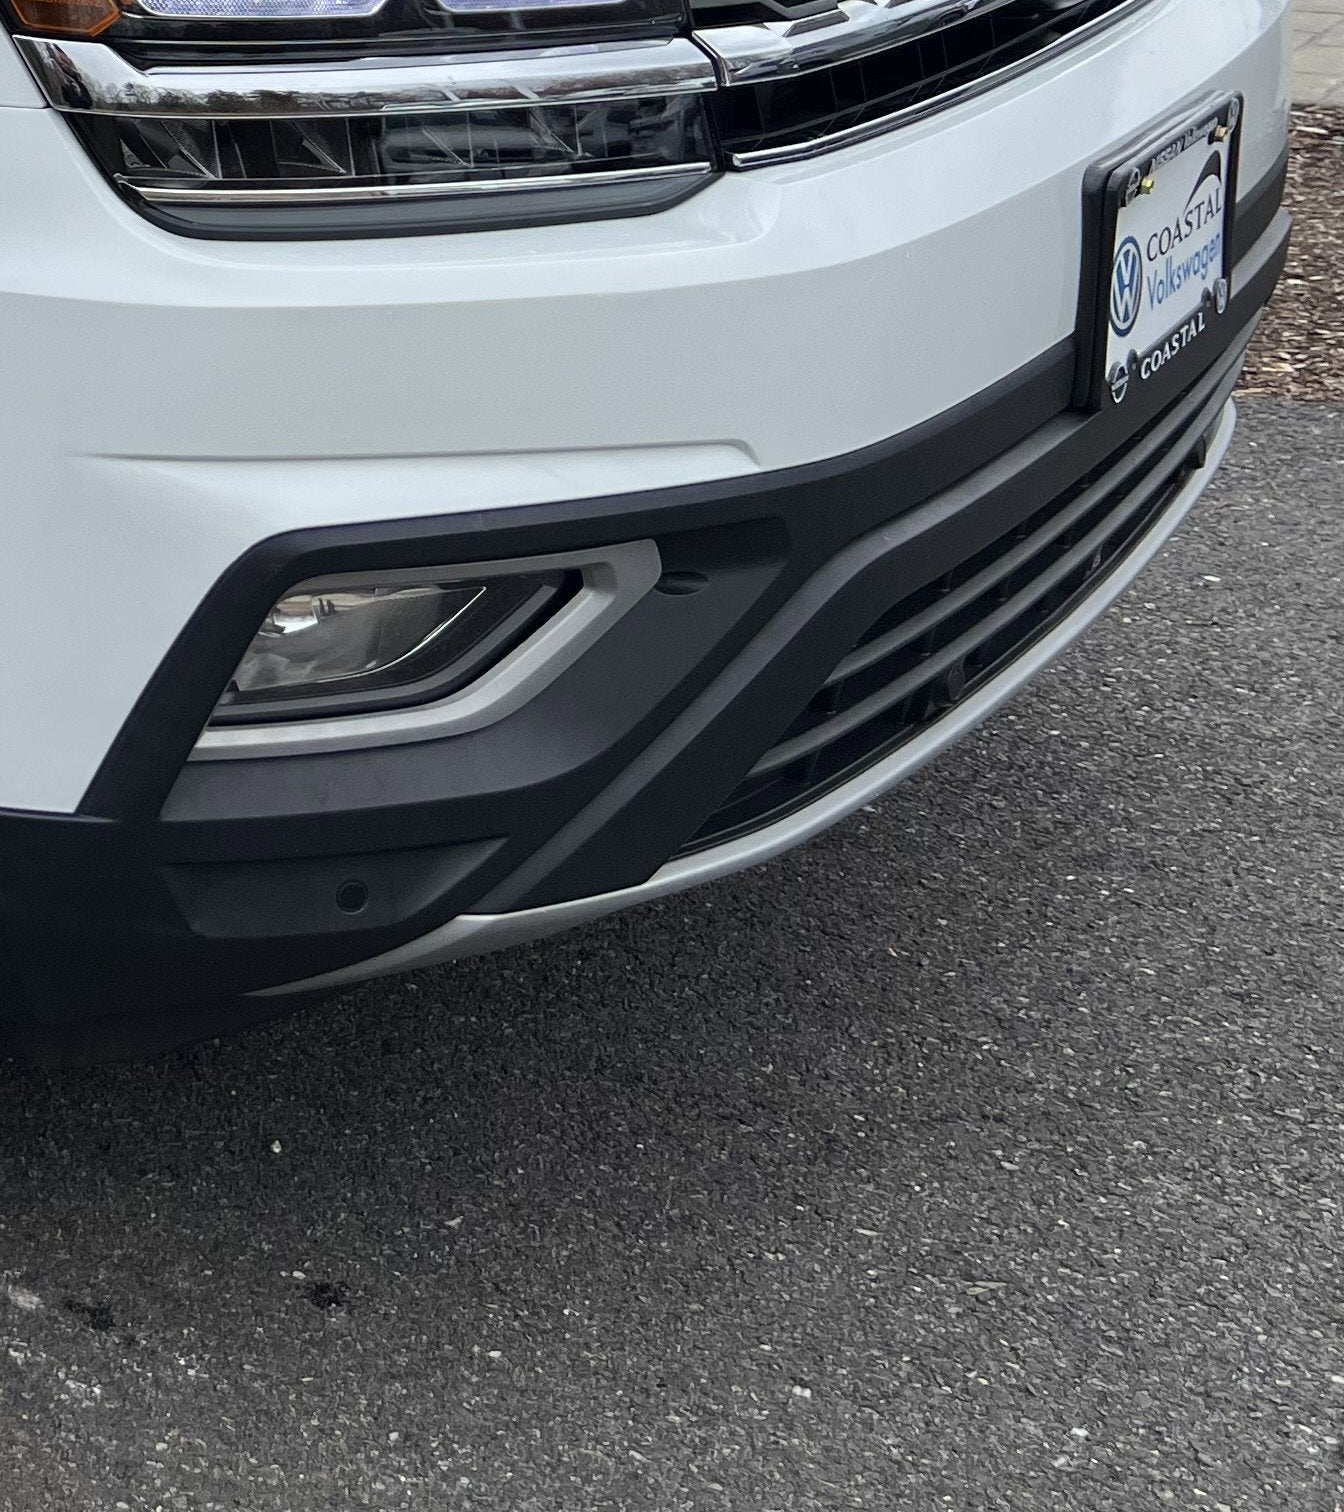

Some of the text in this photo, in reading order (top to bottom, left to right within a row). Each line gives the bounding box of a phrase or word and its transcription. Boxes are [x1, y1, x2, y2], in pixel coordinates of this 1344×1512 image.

[1146, 187, 1223, 262] COASTAL
[1146, 233, 1221, 311] Volkswagen
[1140, 311, 1206, 380] COASTAL
